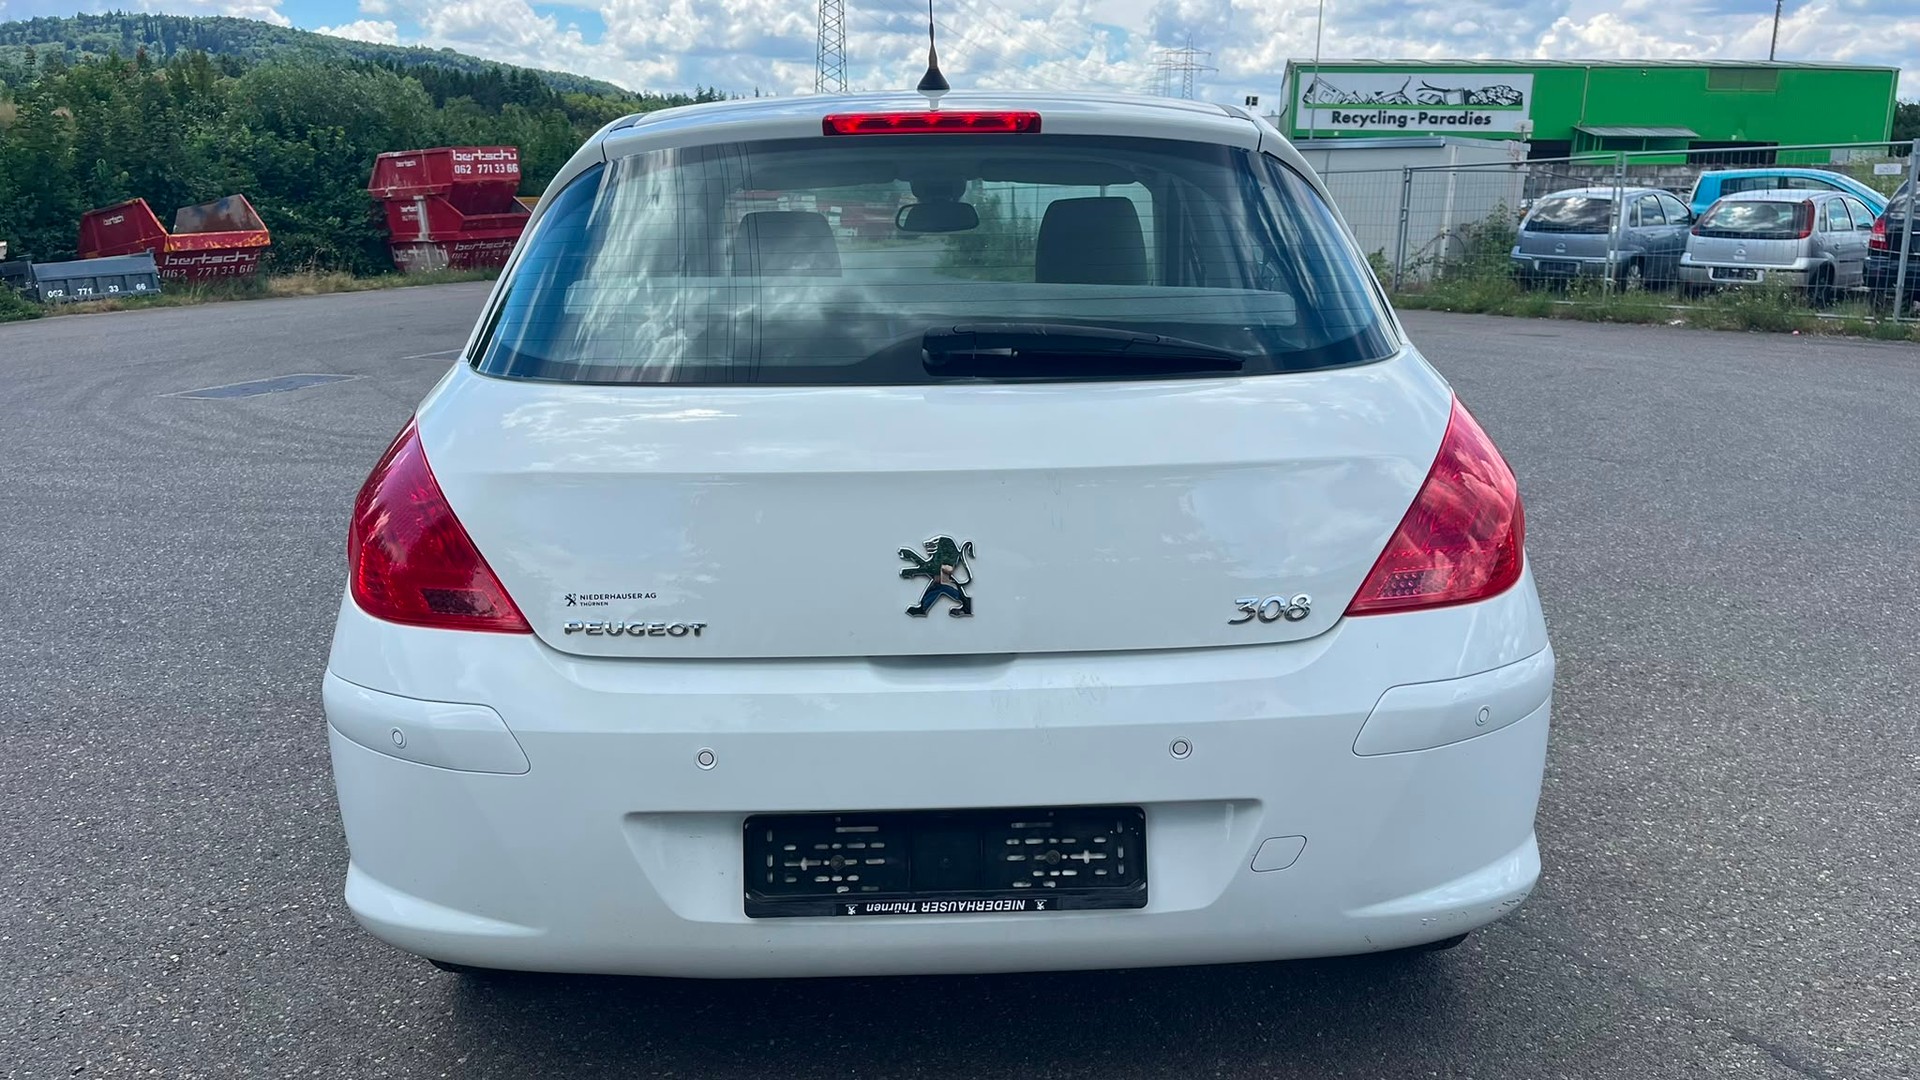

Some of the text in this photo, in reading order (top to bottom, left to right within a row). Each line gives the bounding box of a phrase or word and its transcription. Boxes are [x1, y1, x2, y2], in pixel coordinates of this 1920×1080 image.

[452, 148, 517, 161] bertschi
[454, 163, 519, 174] 062 771 33 66
[197, 266, 217, 277] 771
[221, 265, 235, 275] 33
[238, 263, 254, 274] 66
[77, 287, 93, 296] 771
[108, 285, 120, 293] 33
[580, 592, 657, 601] NIEDERHAUSER AG
[1227, 593, 1312, 625] 308
[563, 620, 708, 637] PEUGEOT
[866, 900, 1025, 913] NIEDERHAUSER Thürnen
